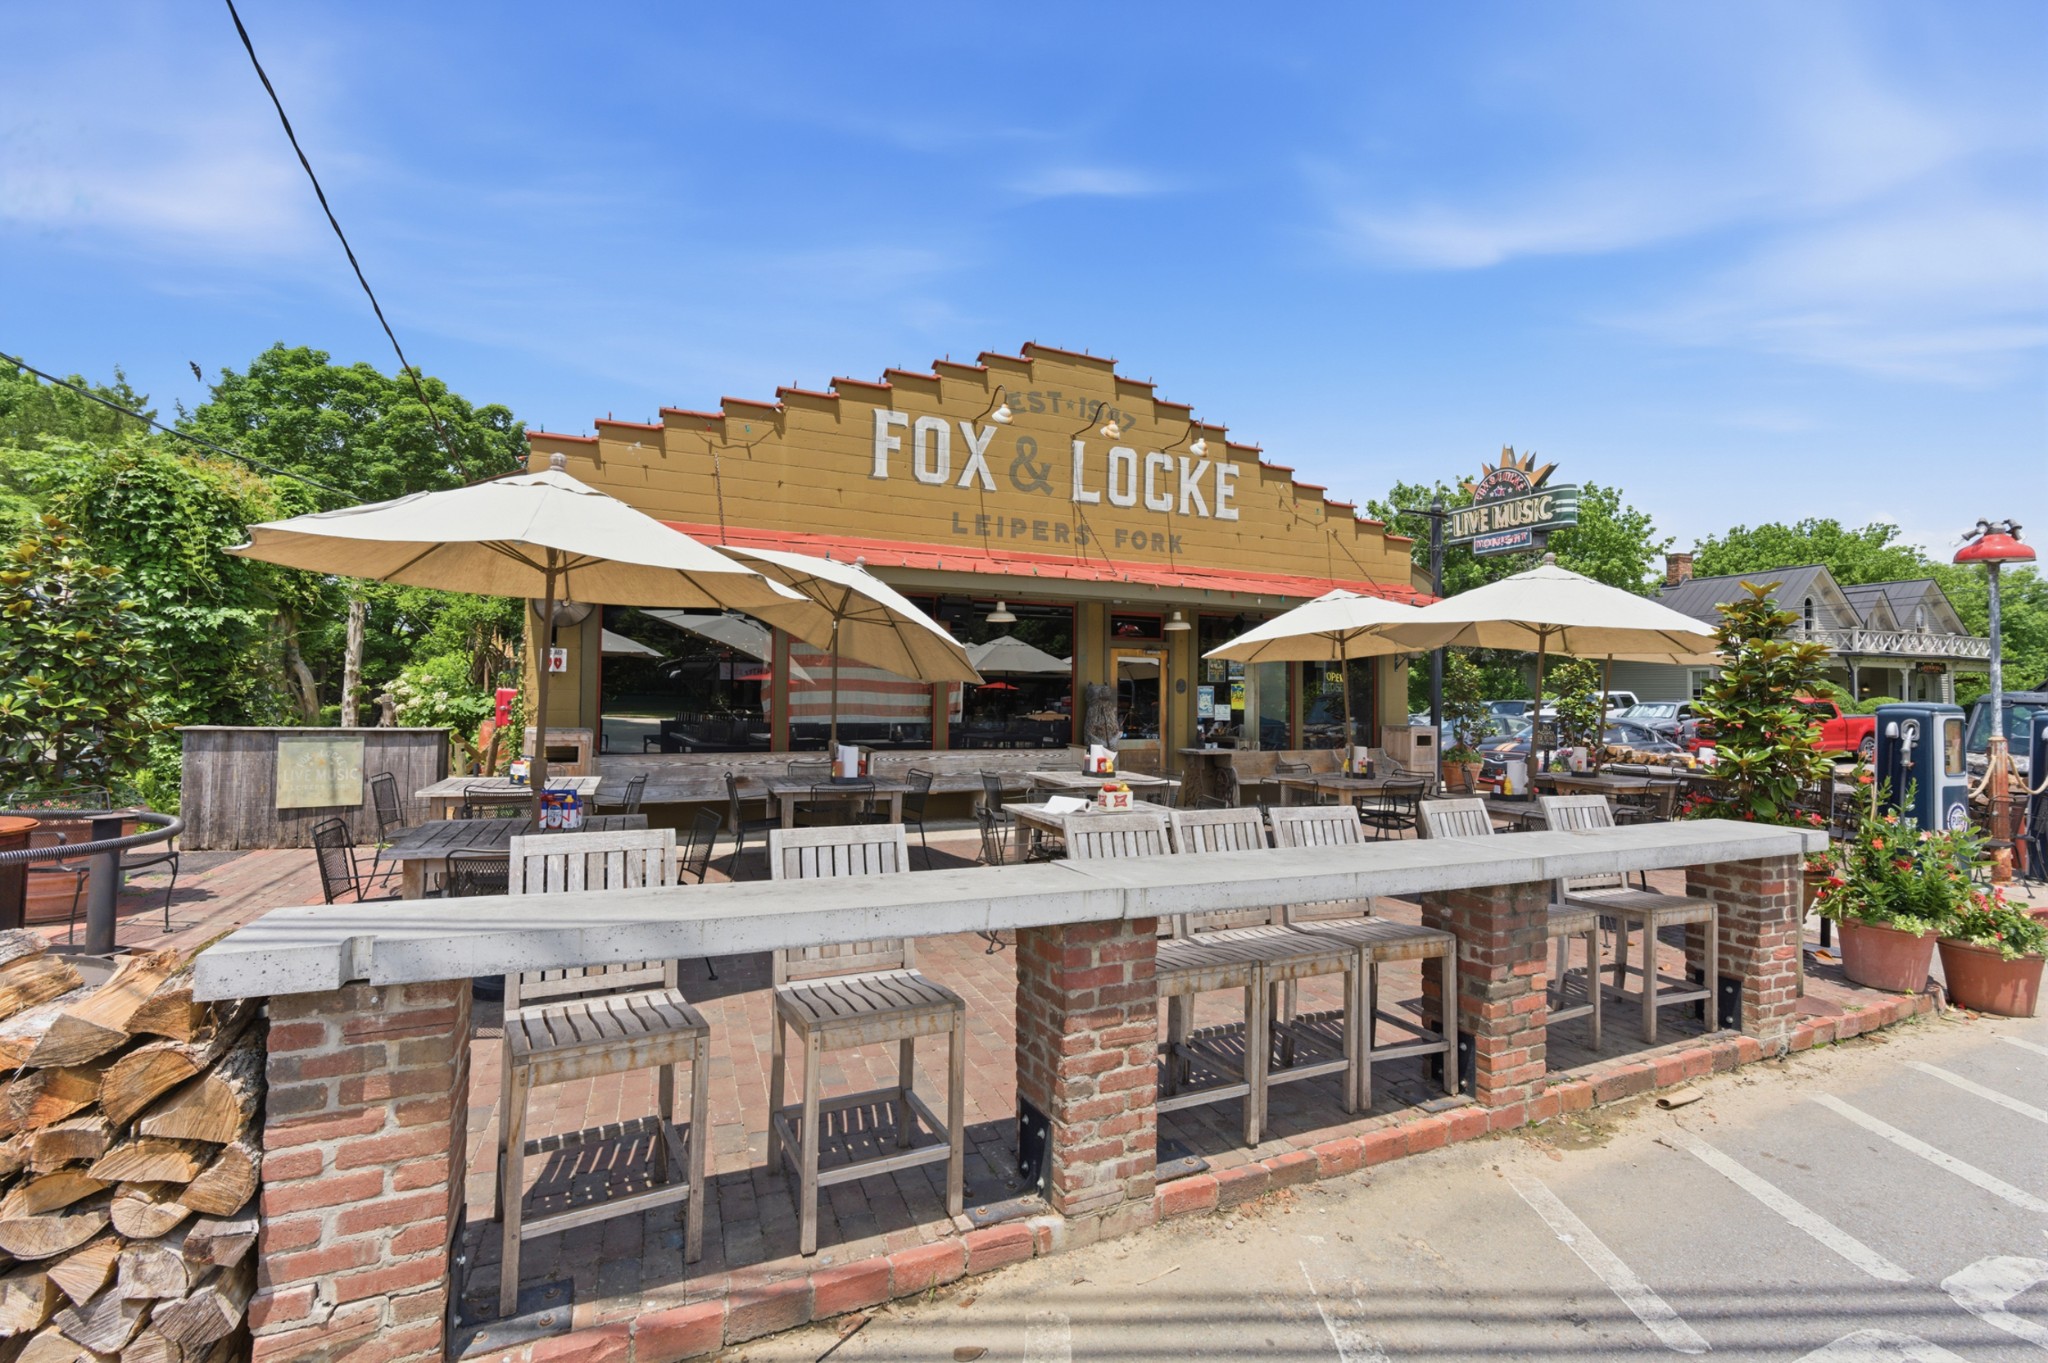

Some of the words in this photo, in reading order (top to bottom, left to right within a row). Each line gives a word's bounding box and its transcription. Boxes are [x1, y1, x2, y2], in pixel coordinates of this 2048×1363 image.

[1006, 391, 1062, 414] EST
[872, 408, 998, 491] FOX
[1009, 435, 1054, 496] &
[1072, 440, 1240, 521] LOCKE
[952, 511, 1091, 546] LEIPERS
[1114, 528, 1184, 554] FORK
[1453, 508, 1489, 537] LIVE
[1492, 495, 1554, 530] MUSIC
[284, 769, 311, 783] LIVE
[315, 768, 358, 782] MUSIC
